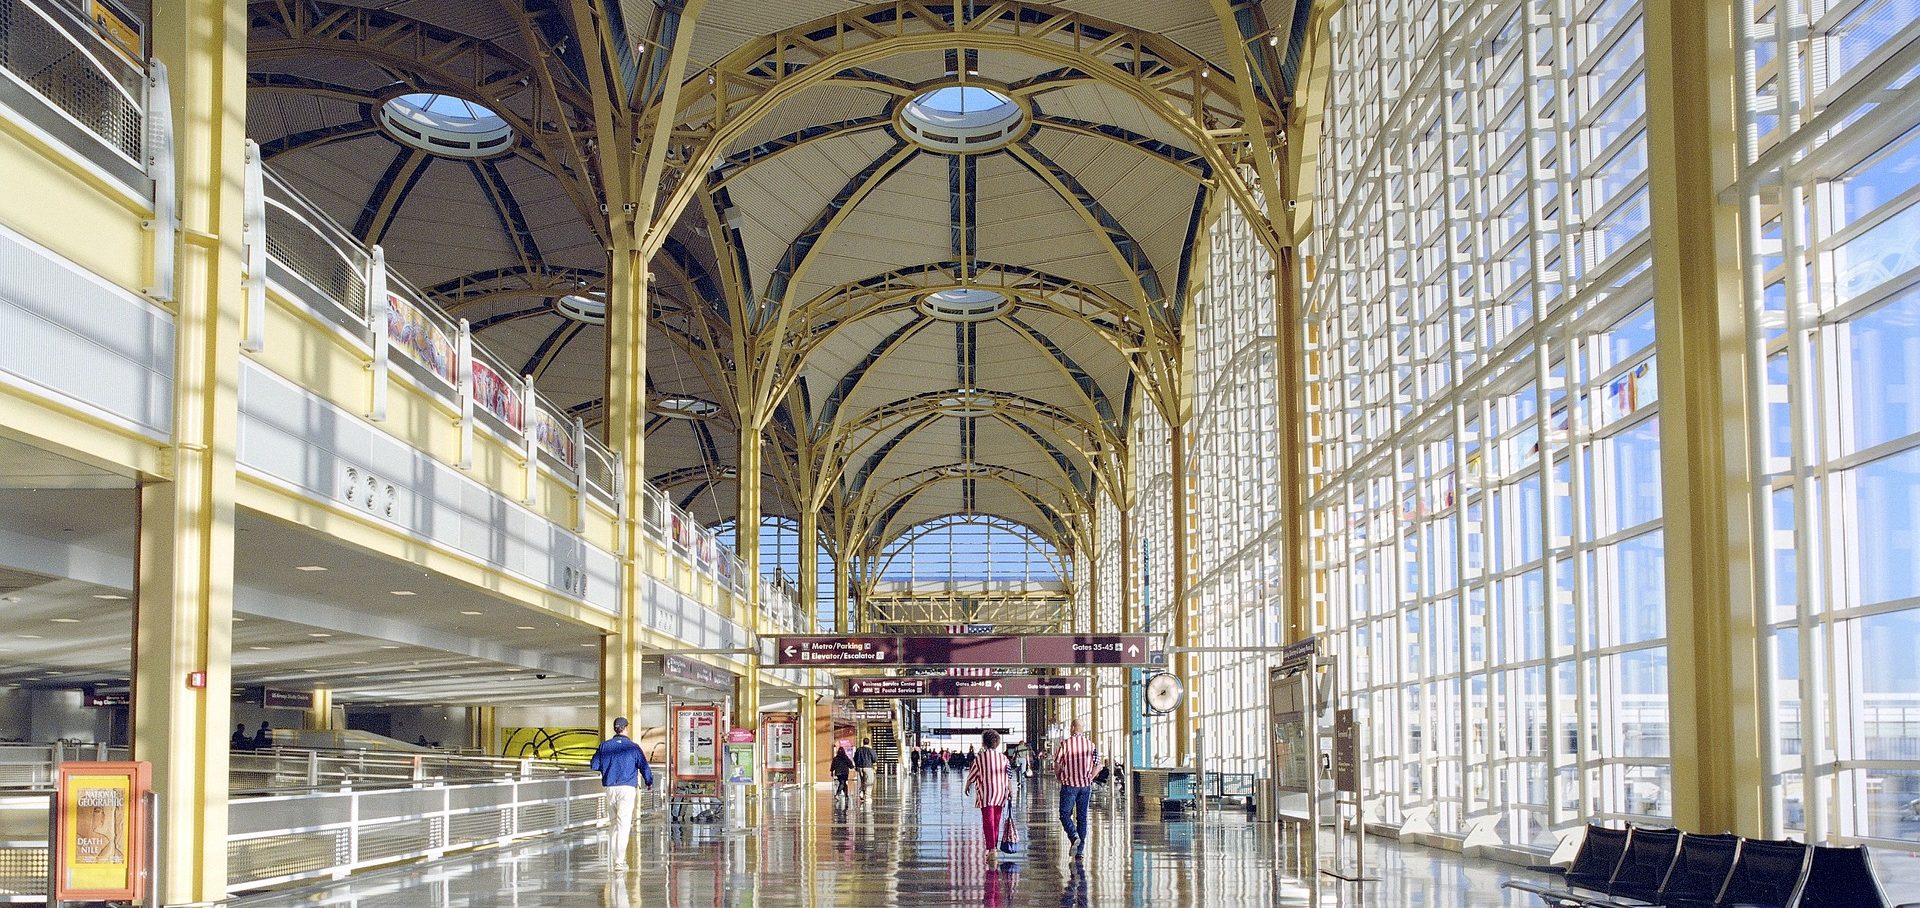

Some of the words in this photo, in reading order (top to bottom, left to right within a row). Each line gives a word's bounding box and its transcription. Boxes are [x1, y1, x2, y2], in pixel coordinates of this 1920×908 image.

[811, 642, 863, 651] Metro/Parking
[1072, 643, 1092, 651] Gates
[1093, 643, 1114, 651] 35-45
[811, 652, 875, 660] Elevator/Escalator
[85, 790, 117, 799] NATIONAL
[78, 798, 123, 807] GEOGRAPHIC
[77, 837, 103, 846] DEATH
[81, 846, 98, 854] NILE
